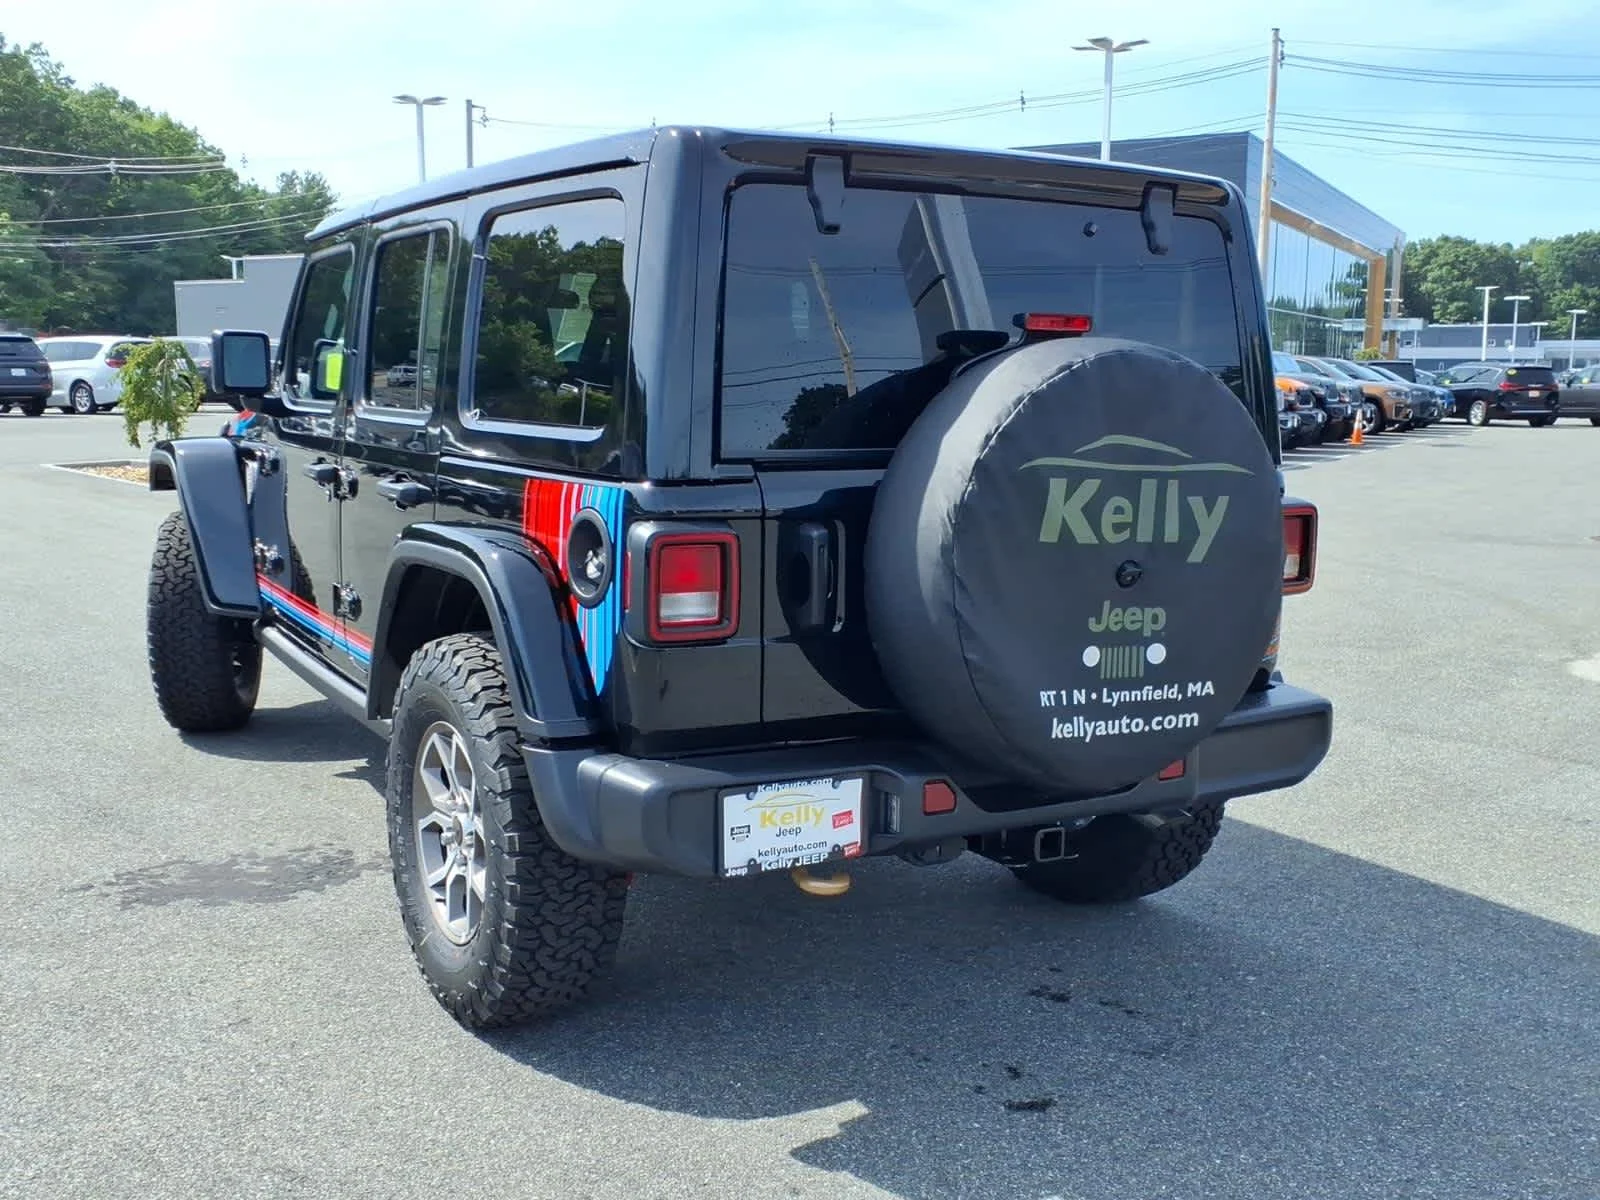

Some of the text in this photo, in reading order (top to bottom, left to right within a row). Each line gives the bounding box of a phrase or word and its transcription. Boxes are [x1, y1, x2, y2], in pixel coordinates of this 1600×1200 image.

[1039, 478, 1230, 563] Kelly
[1088, 600, 1166, 637] Jeep
[1040, 681, 1215, 707] RT 1 N Lynnfield, MA
[1051, 711, 1199, 743] kellyauto.com
[760, 805, 825, 829] Kelly
[775, 827, 802, 837] Jeep
[758, 841, 828, 857] kellyauto.com
[725, 867, 748, 877] Jeep
[761, 852, 829, 872] Kelly JEEP
